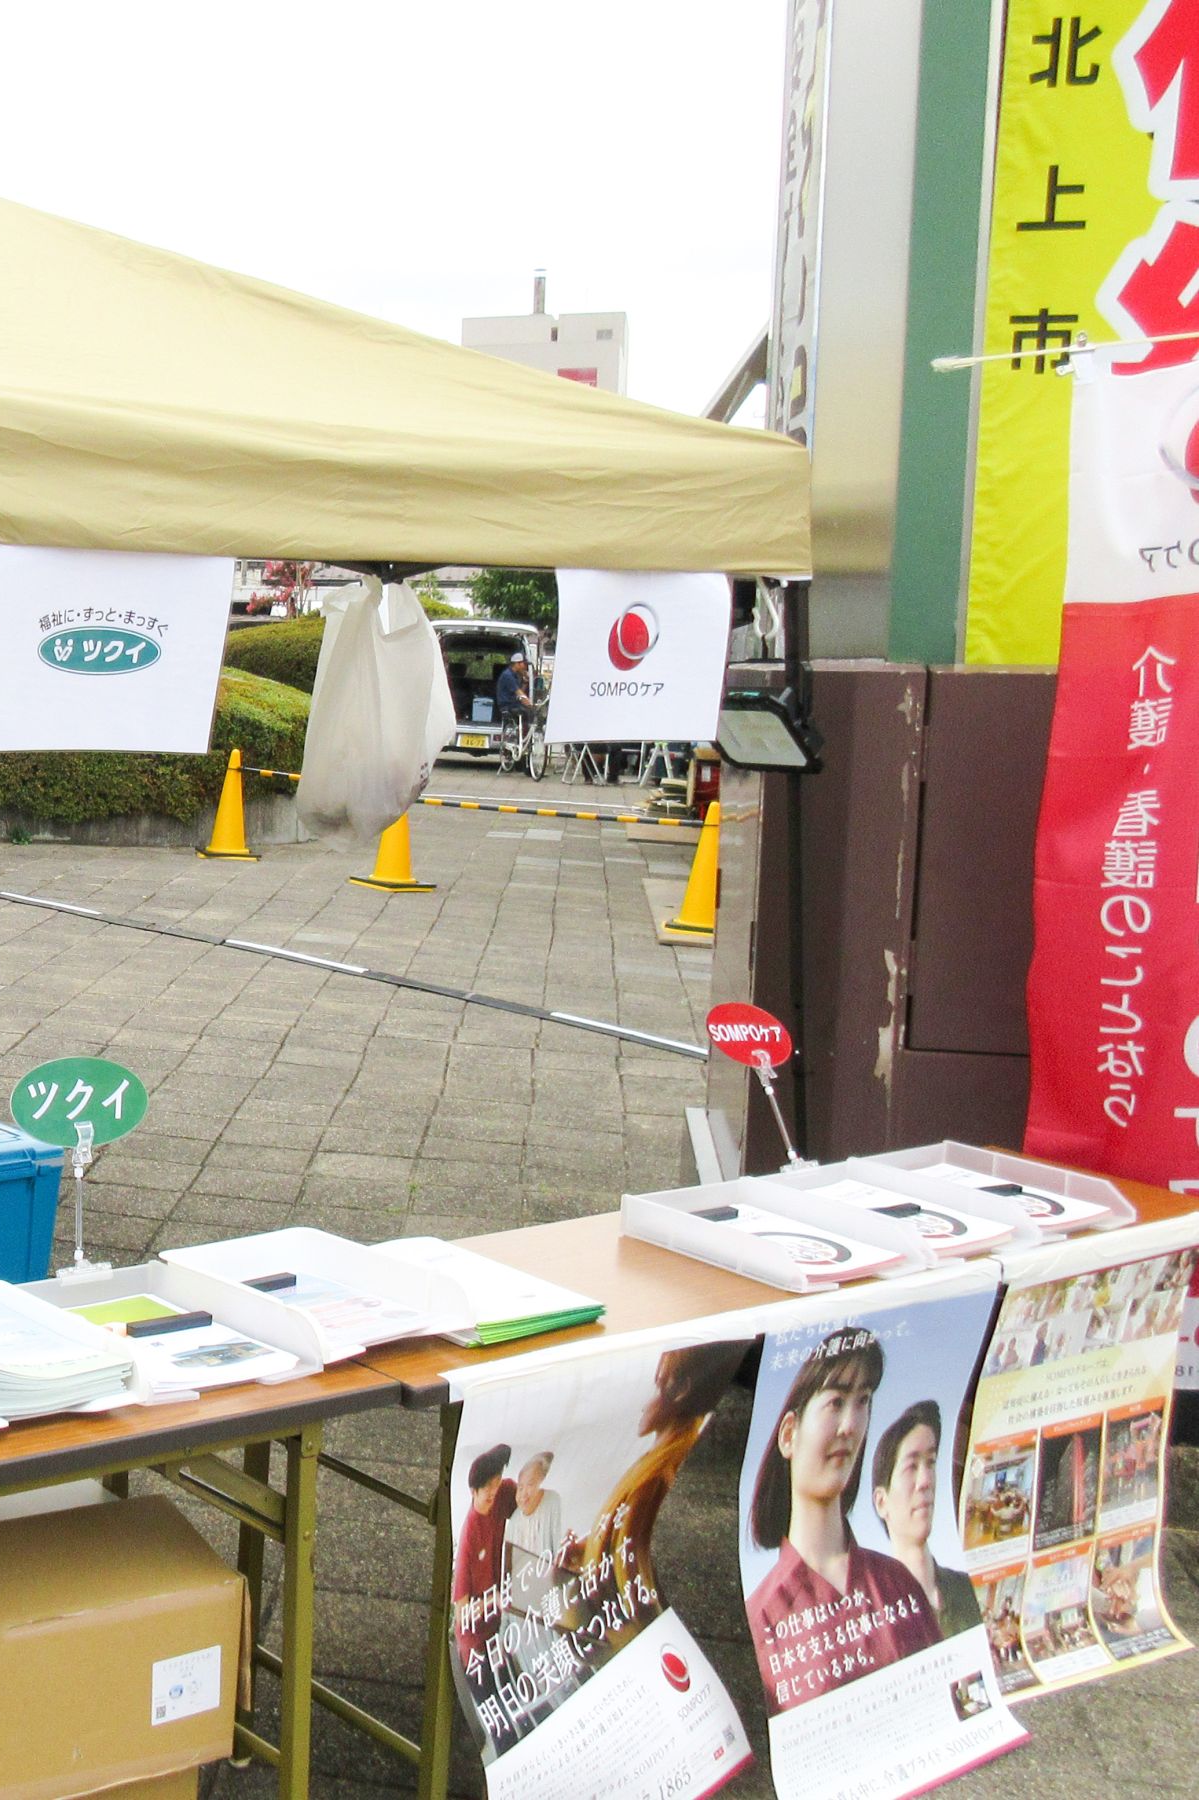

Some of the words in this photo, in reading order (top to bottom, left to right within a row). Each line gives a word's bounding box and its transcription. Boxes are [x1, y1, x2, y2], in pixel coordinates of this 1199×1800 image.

[38, 605, 169, 638] 福祉に・ずっと・まっすぐ
[82, 639, 147, 664] ツクイ
[589, 681, 665, 697] SOMPOケア
[708, 1023, 781, 1042] SOMPOケア
[27, 1078, 130, 1120] ツクイ
[460, 1502, 631, 1636] 昨日までのデータを
[465, 1536, 636, 1686] 今日の介護に活かす。
[764, 1588, 872, 1645] この仕事はいつか、
[769, 1593, 921, 1675] 日本を支える仕事になると
[476, 1574, 658, 1738] 明日の笑顔につなげる。
[776, 1647, 875, 1705] 信じているから。
